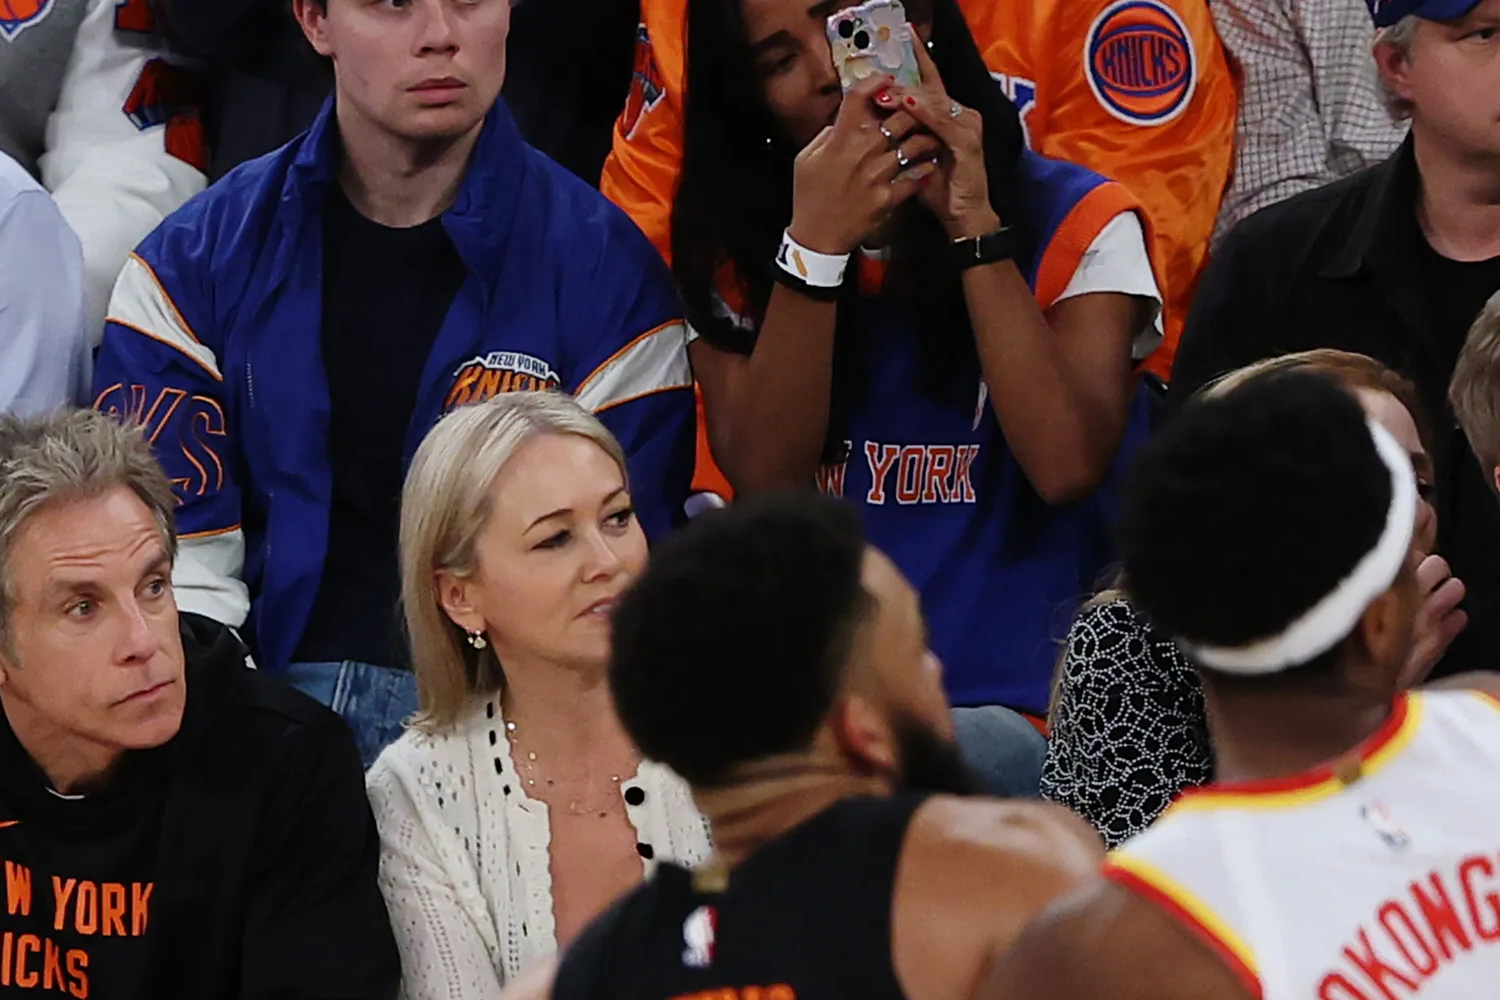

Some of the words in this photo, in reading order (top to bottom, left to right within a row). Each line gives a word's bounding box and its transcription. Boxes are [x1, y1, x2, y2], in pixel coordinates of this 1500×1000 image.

[487, 352, 517, 368] NEW
[517, 355, 548, 378] YORK
[864, 440, 980, 505] YORK
[51, 875, 154, 937] YORK
